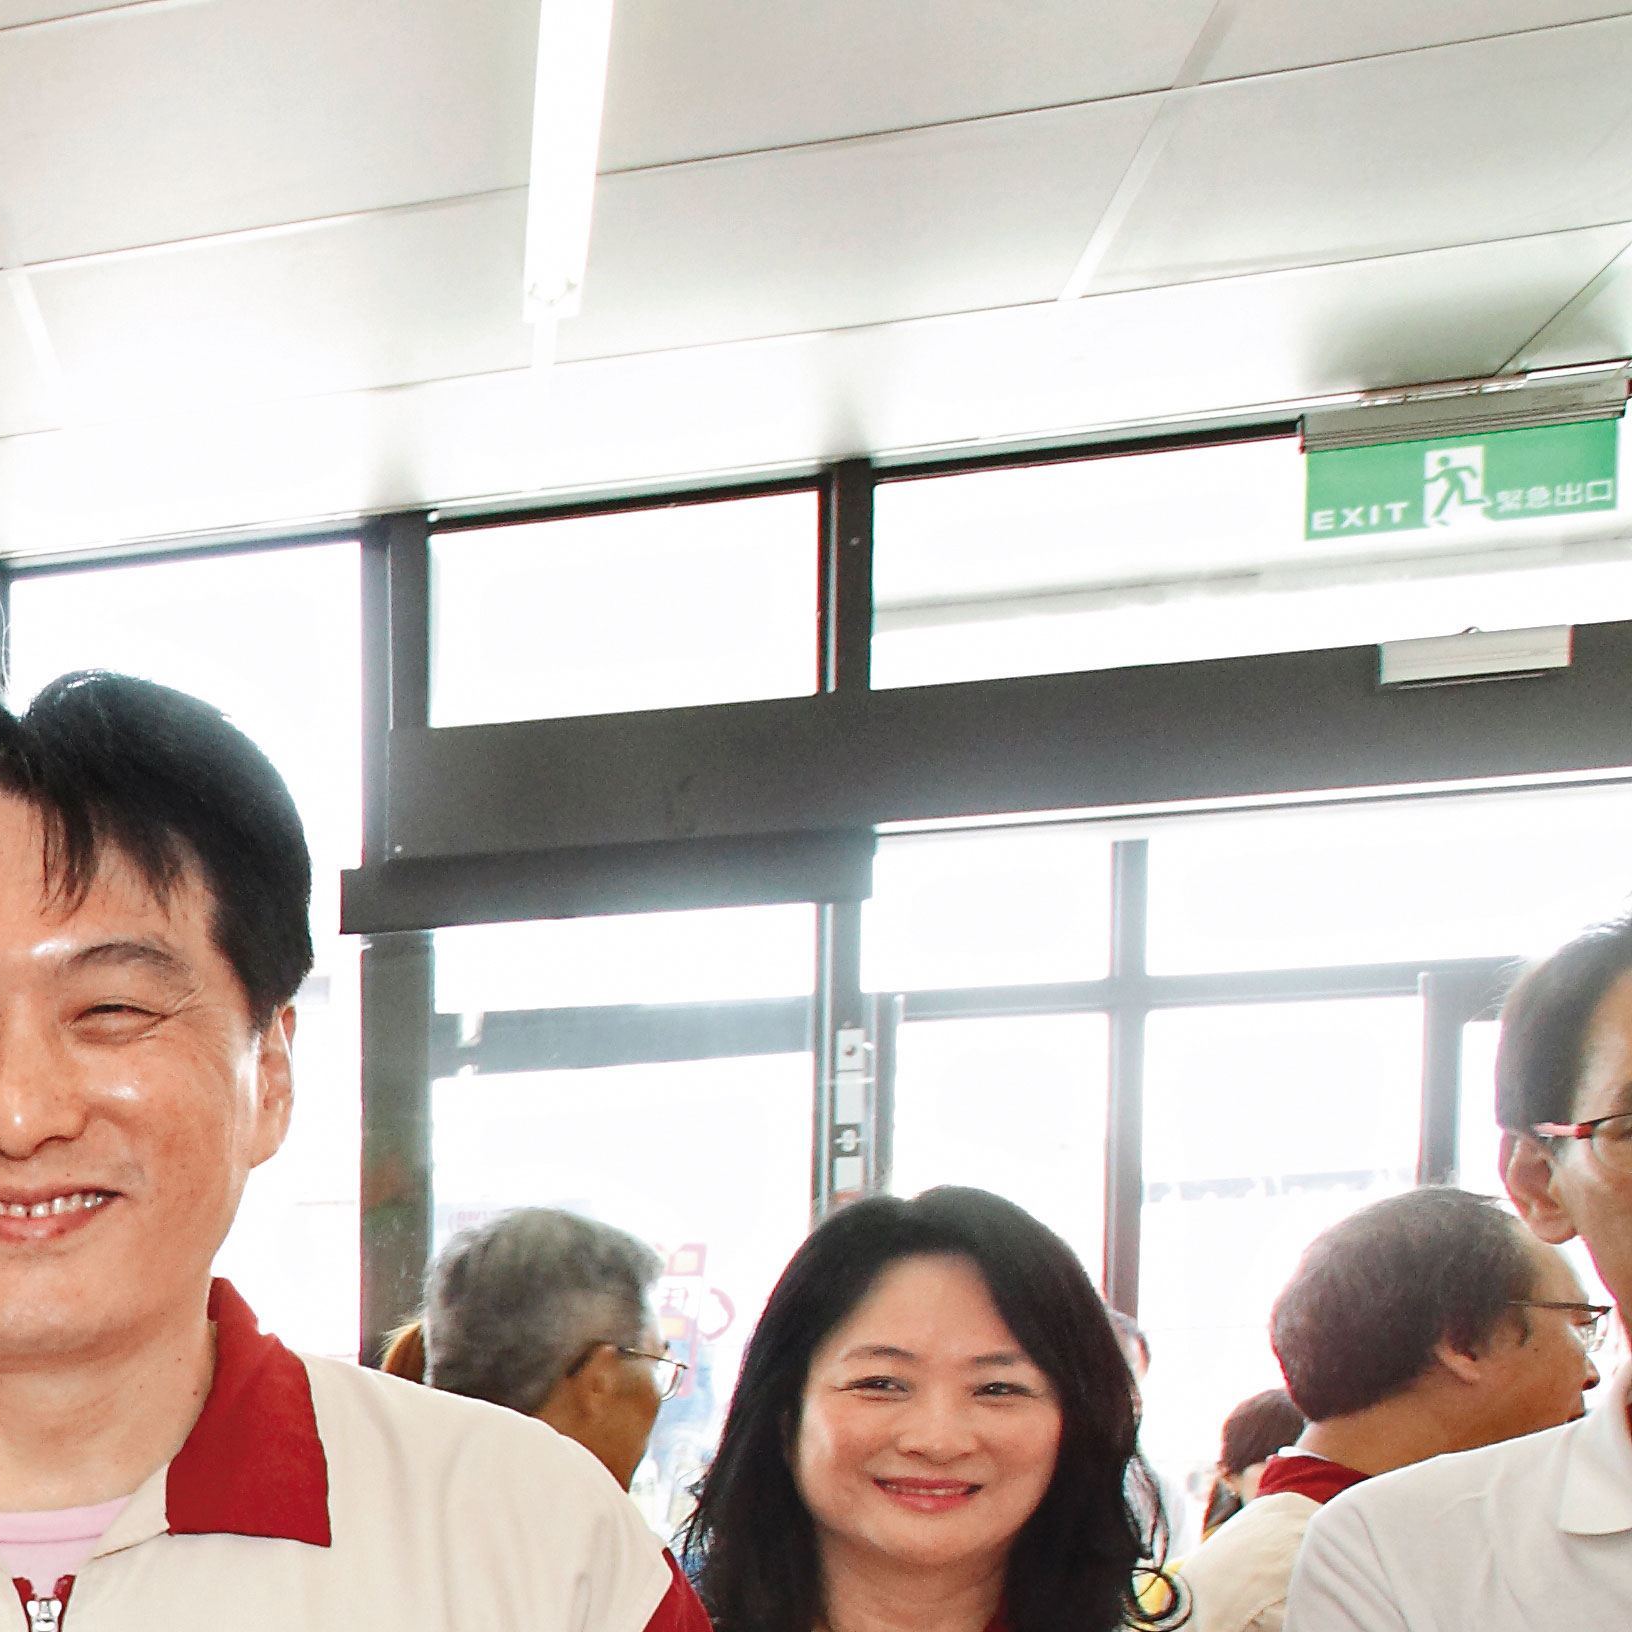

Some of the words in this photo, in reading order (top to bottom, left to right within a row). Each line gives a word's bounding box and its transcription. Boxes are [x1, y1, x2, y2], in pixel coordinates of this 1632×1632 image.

[1496, 479, 1615, 513] 緊急出口
[1311, 502, 1410, 533] EXIT
